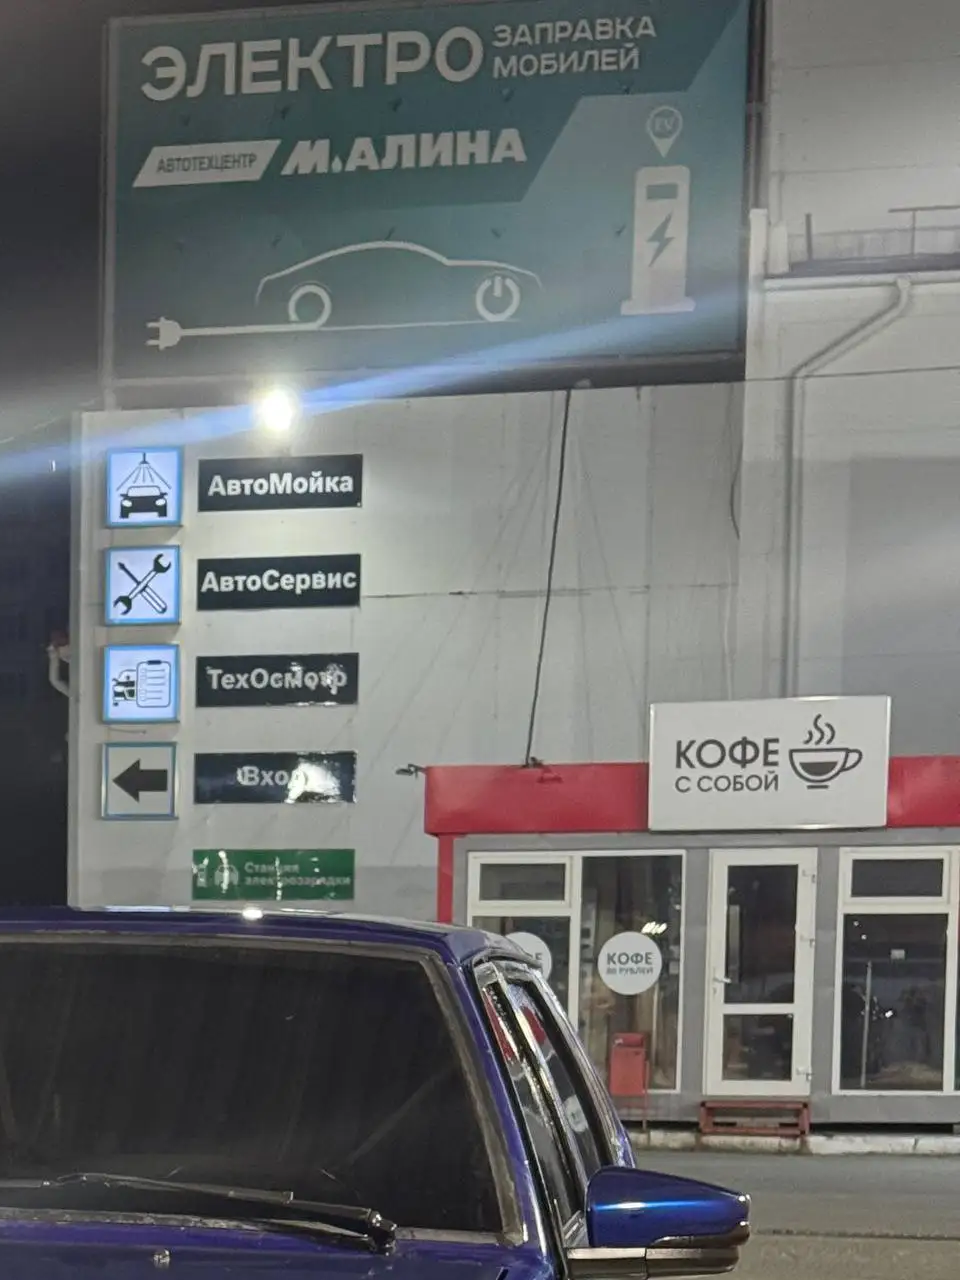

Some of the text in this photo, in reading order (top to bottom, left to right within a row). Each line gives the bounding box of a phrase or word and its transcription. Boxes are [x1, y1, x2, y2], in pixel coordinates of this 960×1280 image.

[492, 16, 657, 48] ЗАПРАВКА
[140, 26, 484, 101] ЭЛЕКТРО
[493, 43, 640, 79] МОБИЛЕЙ
[156, 152, 258, 174] АВТОТЕХЦЕНТР
[207, 470, 354, 497] АвтоМойка
[200, 569, 357, 595] АвтоСервис
[675, 737, 780, 769] КОФЕ
[240, 764, 307, 787] Вхо
[675, 770, 779, 793] С СОБОЙ
[606, 951, 653, 966] КОФЕ
